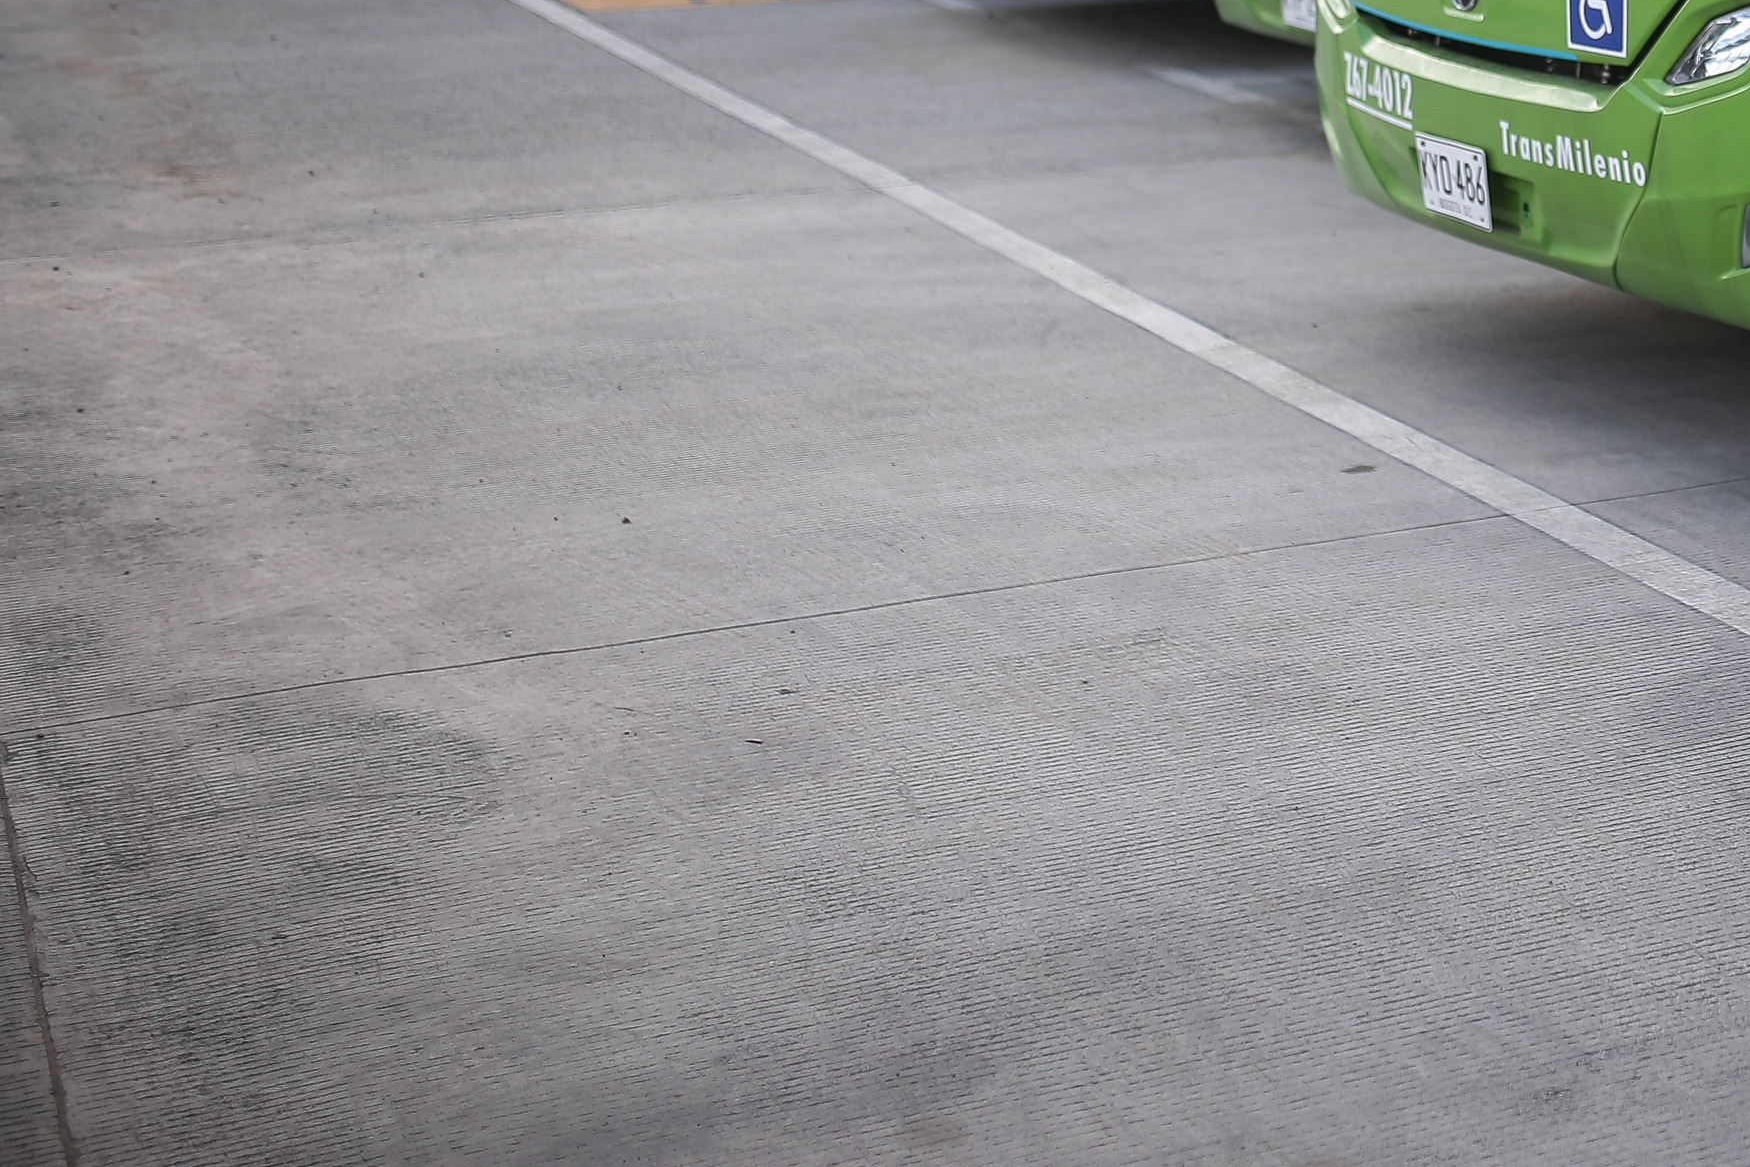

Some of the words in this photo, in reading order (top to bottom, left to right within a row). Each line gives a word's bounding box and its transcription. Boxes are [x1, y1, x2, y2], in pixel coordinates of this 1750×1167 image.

[1344, 52, 1414, 120] Z67-4012
[1456, 160, 1485, 206] 486
[1499, 120, 1646, 187] TransMilenio
